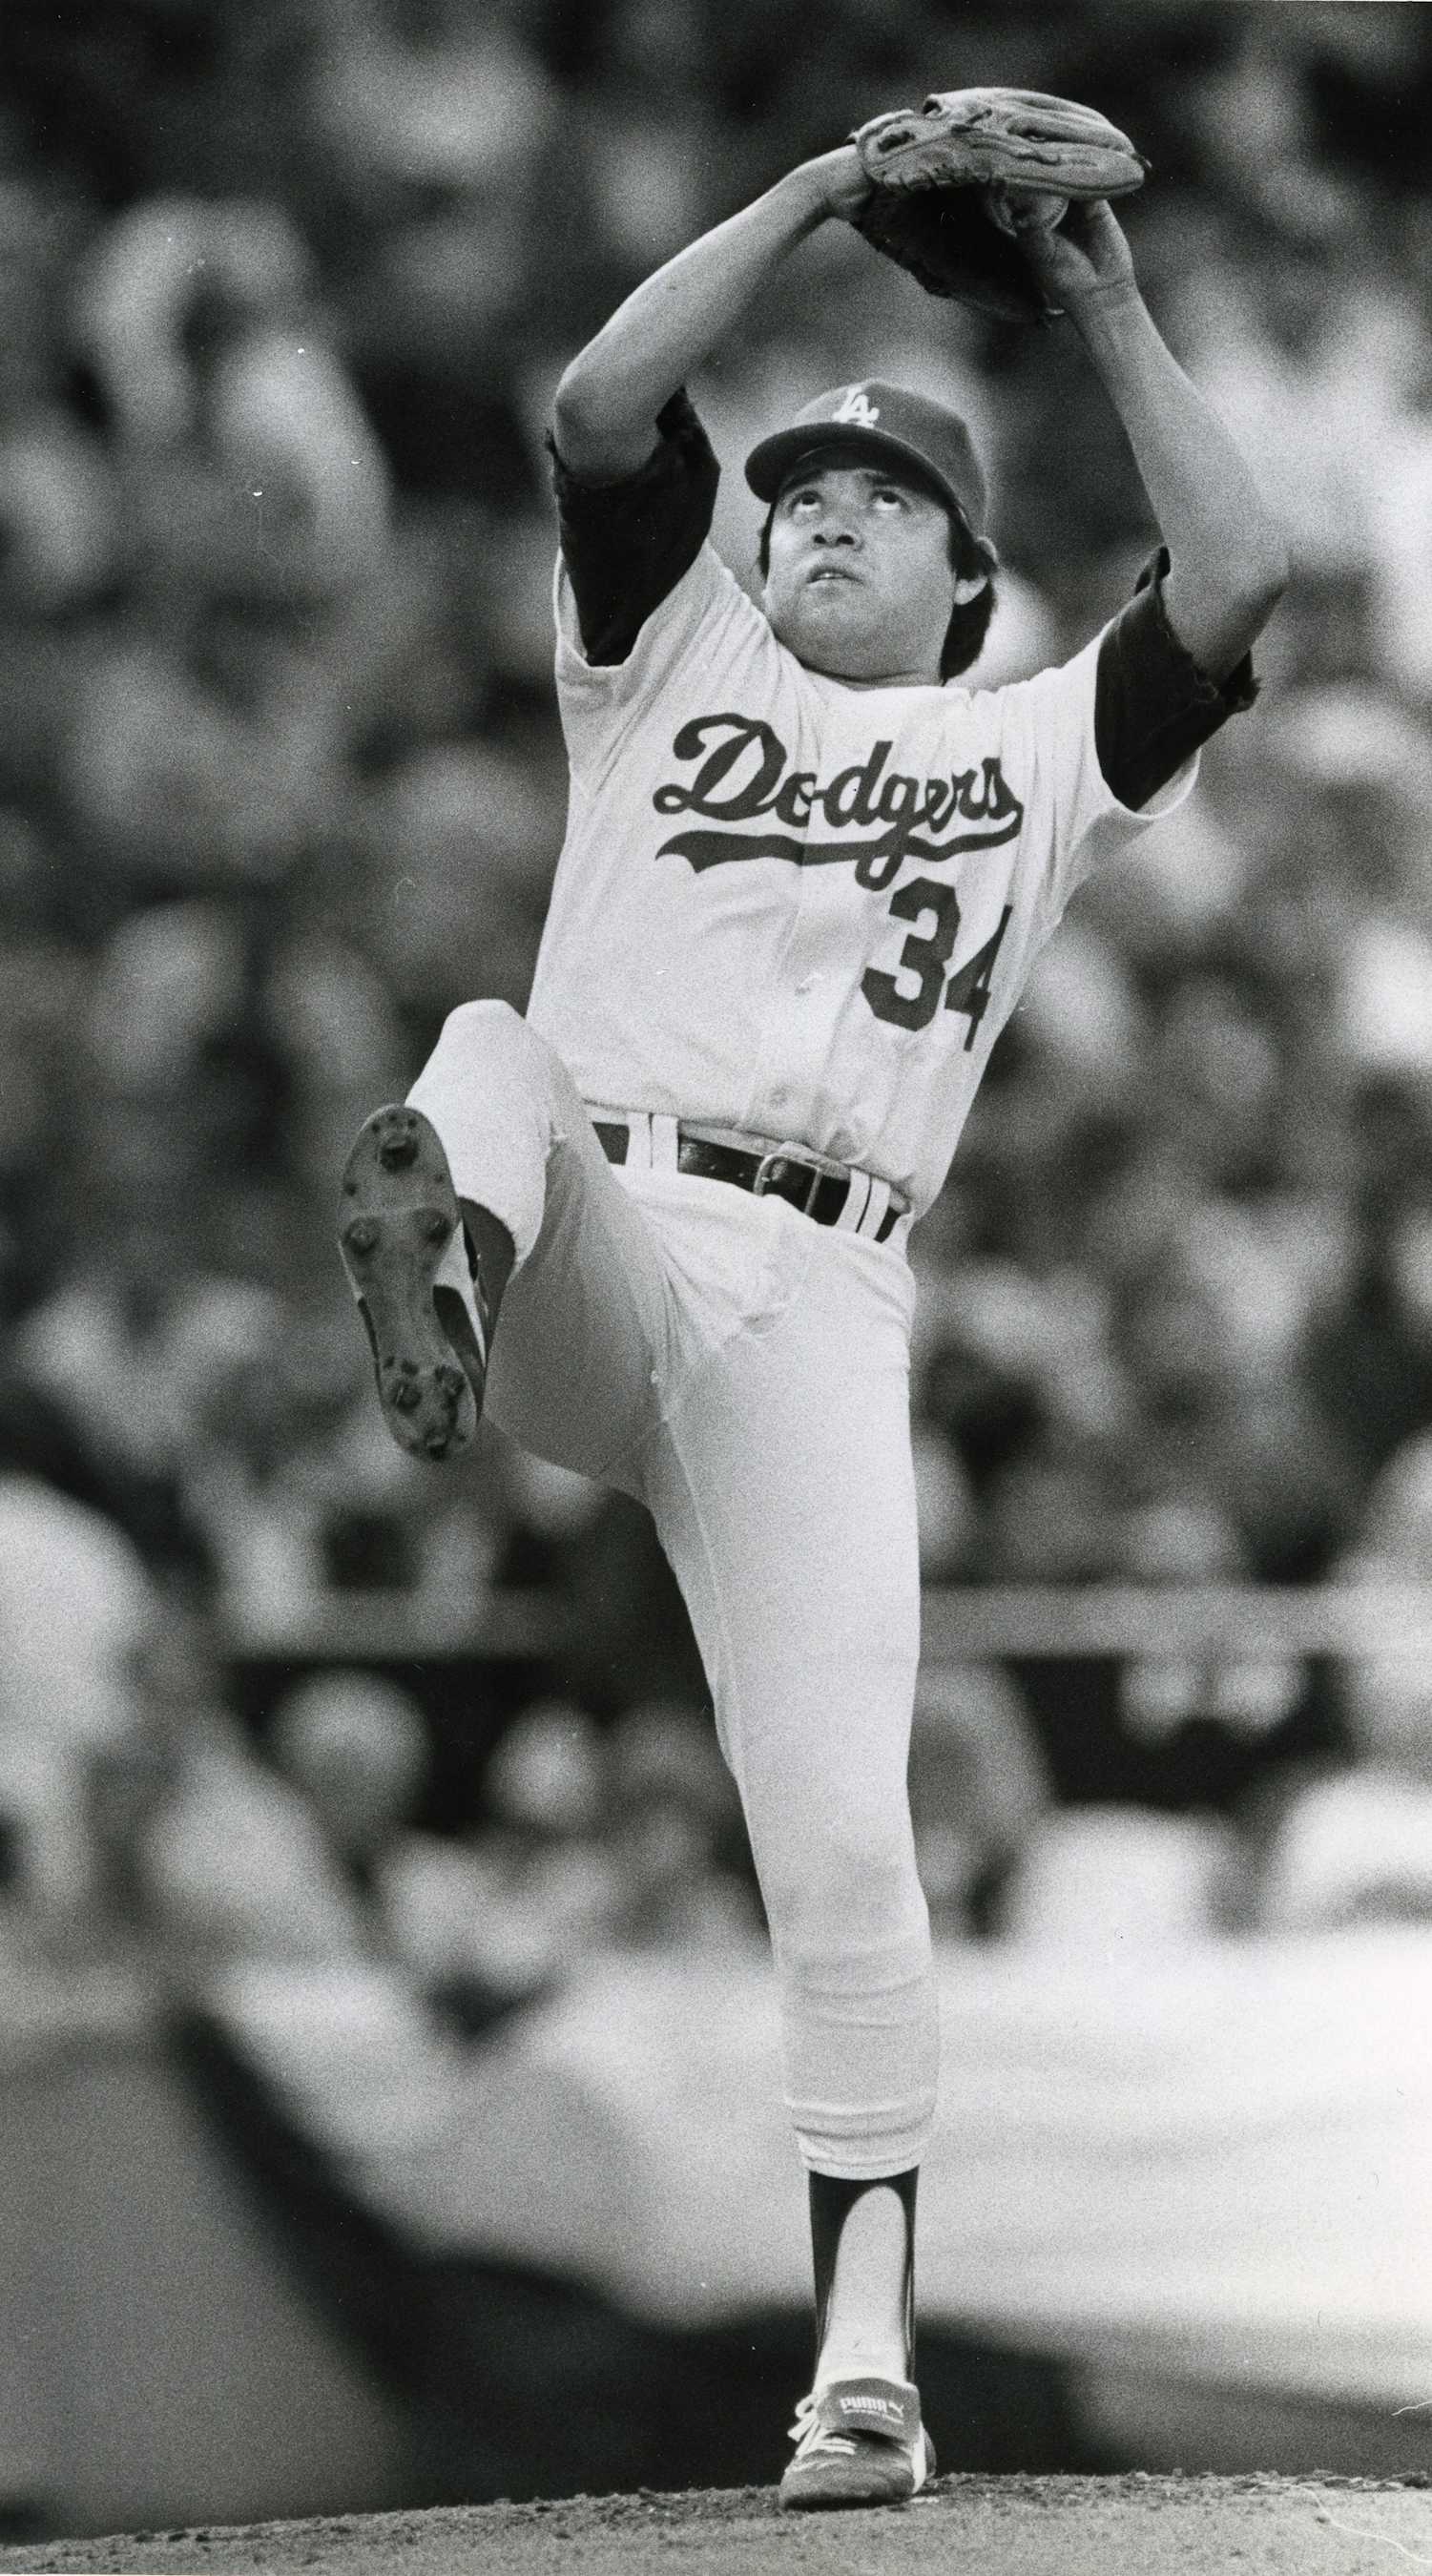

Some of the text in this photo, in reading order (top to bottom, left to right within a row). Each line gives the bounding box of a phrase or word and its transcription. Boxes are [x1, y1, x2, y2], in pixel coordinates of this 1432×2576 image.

[653, 713, 1025, 892] Dodgers
[861, 877, 1013, 1051] 34
[841, 2396, 888, 2414] PUMA
